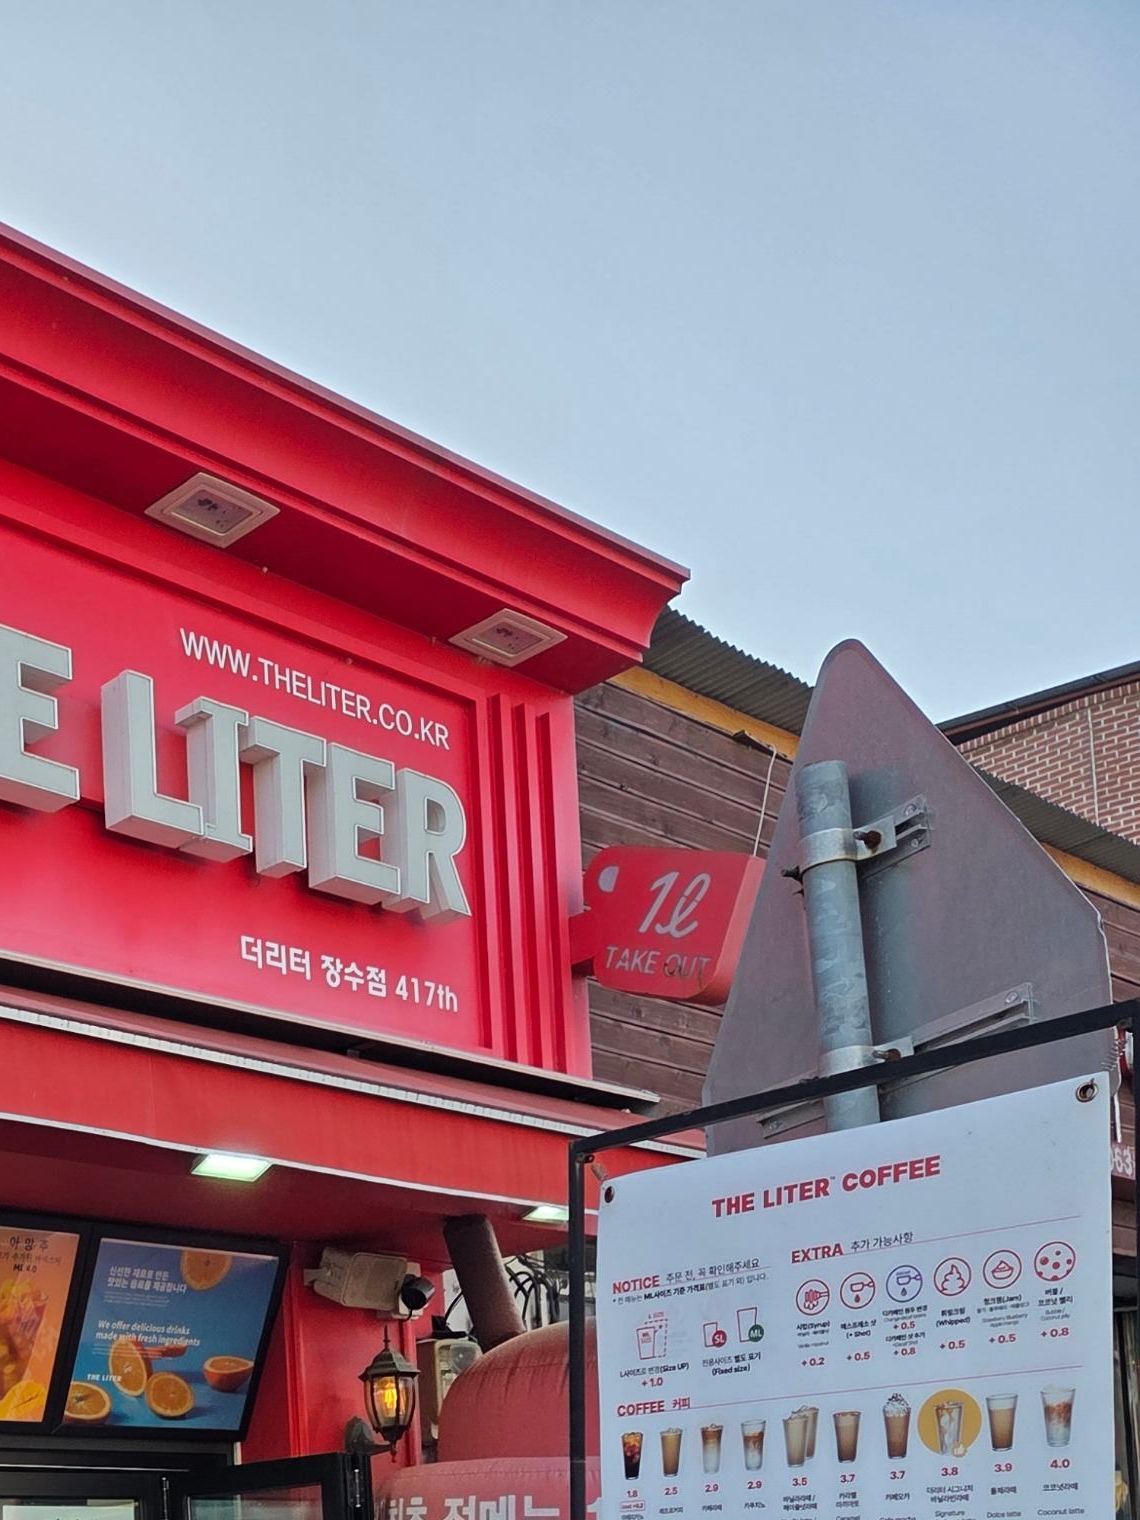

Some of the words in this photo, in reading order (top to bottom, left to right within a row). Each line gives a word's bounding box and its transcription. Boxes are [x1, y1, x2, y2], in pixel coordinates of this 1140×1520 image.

[179, 628, 450, 751] WWW.THELITER.CO.KR
[100, 669, 471, 924] LITER
[606, 947, 661, 975] TAKE
[664, 954, 711, 980] OUT
[240, 935, 312, 982] 더리터
[320, 955, 387, 997] 장수점
[395, 974, 458, 1012] 417th
[712, 1192, 755, 1218] THE
[763, 1177, 830, 1209] LITER
[842, 1155, 941, 1192] COFFEE
[791, 1243, 844, 1264] EXTRA
[851, 1237, 870, 1251] 추가
[873, 1231, 913, 1249] 가능사항
[110, 1266, 131, 1278] 신선한
[612, 1275, 660, 1294] NOTICE
[98, 1319, 110, 1329] We
[111, 1321, 130, 1331] offer
[131, 1322, 165, 1334] delicious
[166, 1325, 190, 1335] drinks
[750, 1329, 762, 1338] ML
[96, 1331, 117, 1341] made
[118, 1332, 137, 1342] with
[138, 1333, 158, 1344] fresh
[158, 1335, 201, 1347] ingredients
[714, 1334, 725, 1343] SL
[87, 1373, 100, 1381] THE
[102, 1374, 122, 1382] LITER
[617, 1400, 665, 1417] COFFEE
[672, 1397, 691, 1410] 커피
[941, 1467, 958, 1476] 3.8
[1050, 1459, 1070, 1469] 4.0
[792, 1477, 808, 1487] 3.5
[1037, 1508, 1067, 1516] Coconut
[1069, 1507, 1085, 1515] latte
